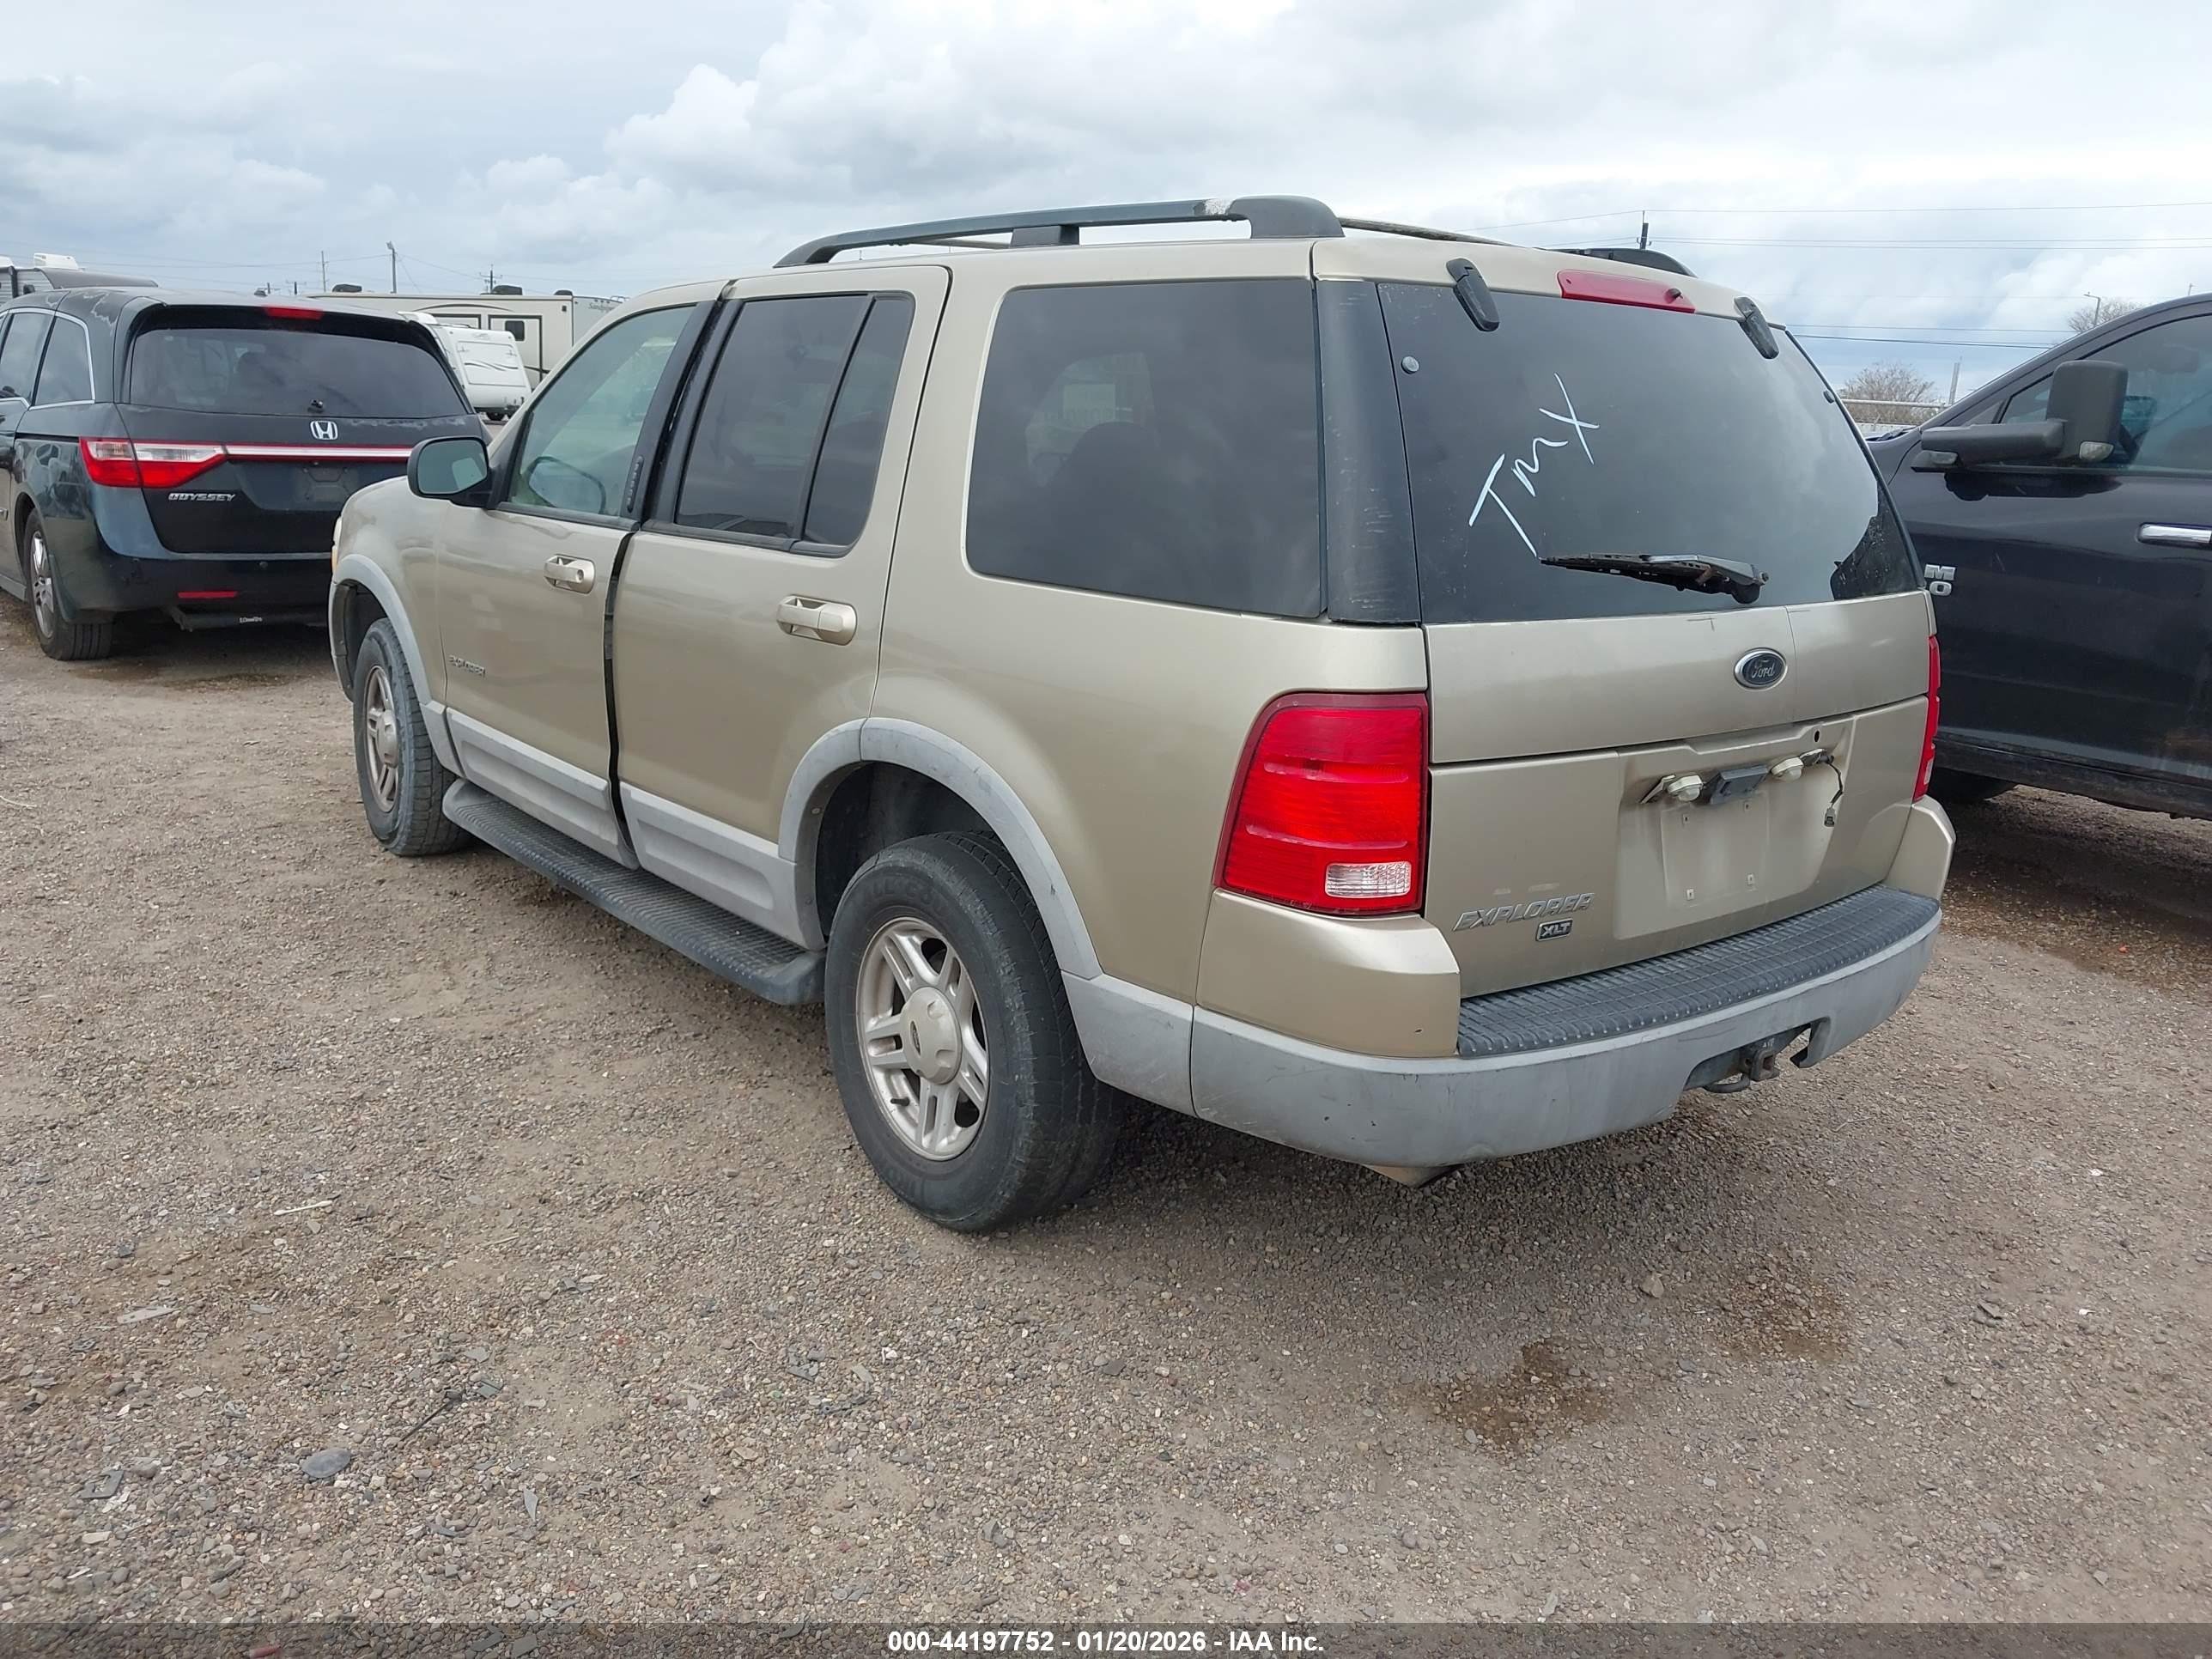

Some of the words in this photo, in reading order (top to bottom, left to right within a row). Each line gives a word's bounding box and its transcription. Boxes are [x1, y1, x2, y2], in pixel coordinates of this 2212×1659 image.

[168, 492, 235, 501] ODYSSEY
[1751, 659, 1776, 678] Ford
[1452, 892, 1595, 932] EXPLORER
[1541, 921, 1571, 939] XLT
